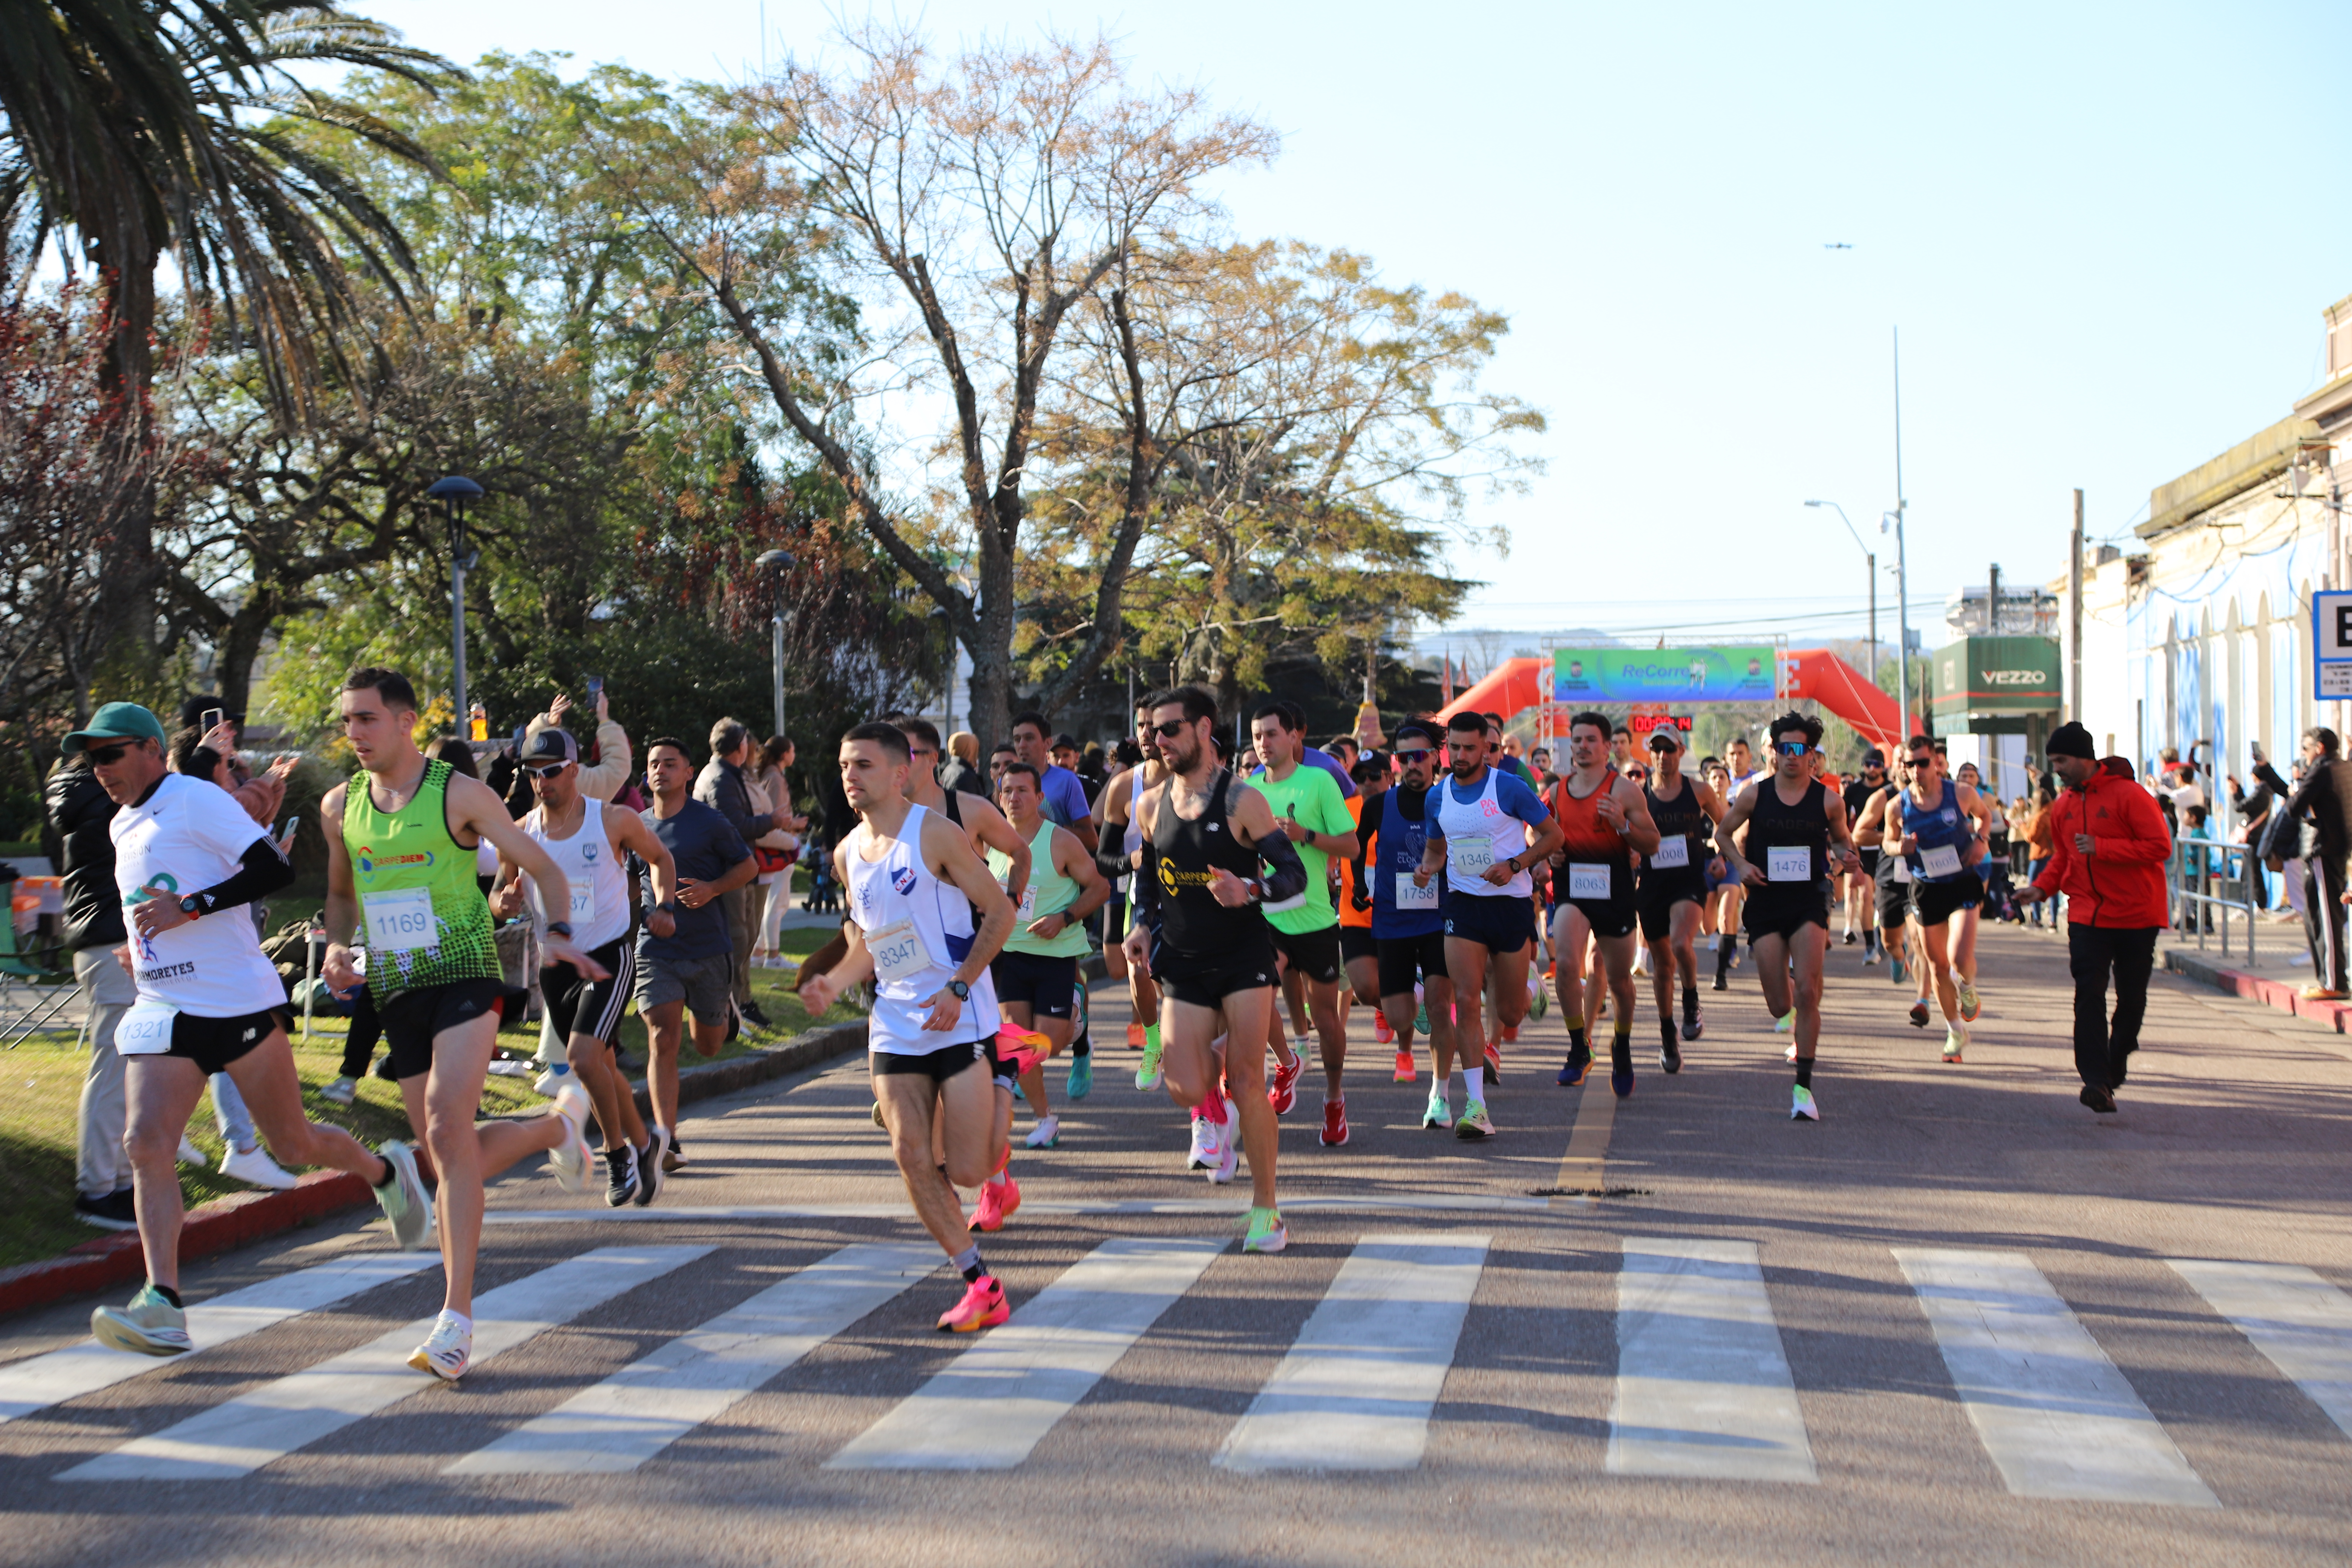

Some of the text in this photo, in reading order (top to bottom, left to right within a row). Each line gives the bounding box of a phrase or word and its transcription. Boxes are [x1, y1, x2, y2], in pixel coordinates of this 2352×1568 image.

[1981, 670, 2047, 685] VEZZO
[1460, 853, 1491, 866] 1346
[1775, 861, 1806, 872] 1476
[1575, 877, 1606, 891] 8063
[1403, 888, 1434, 899] 1758
[377, 913, 426, 935] 1169
[880, 939, 917, 967] 8347
[123, 1020, 164, 1040] 1321
